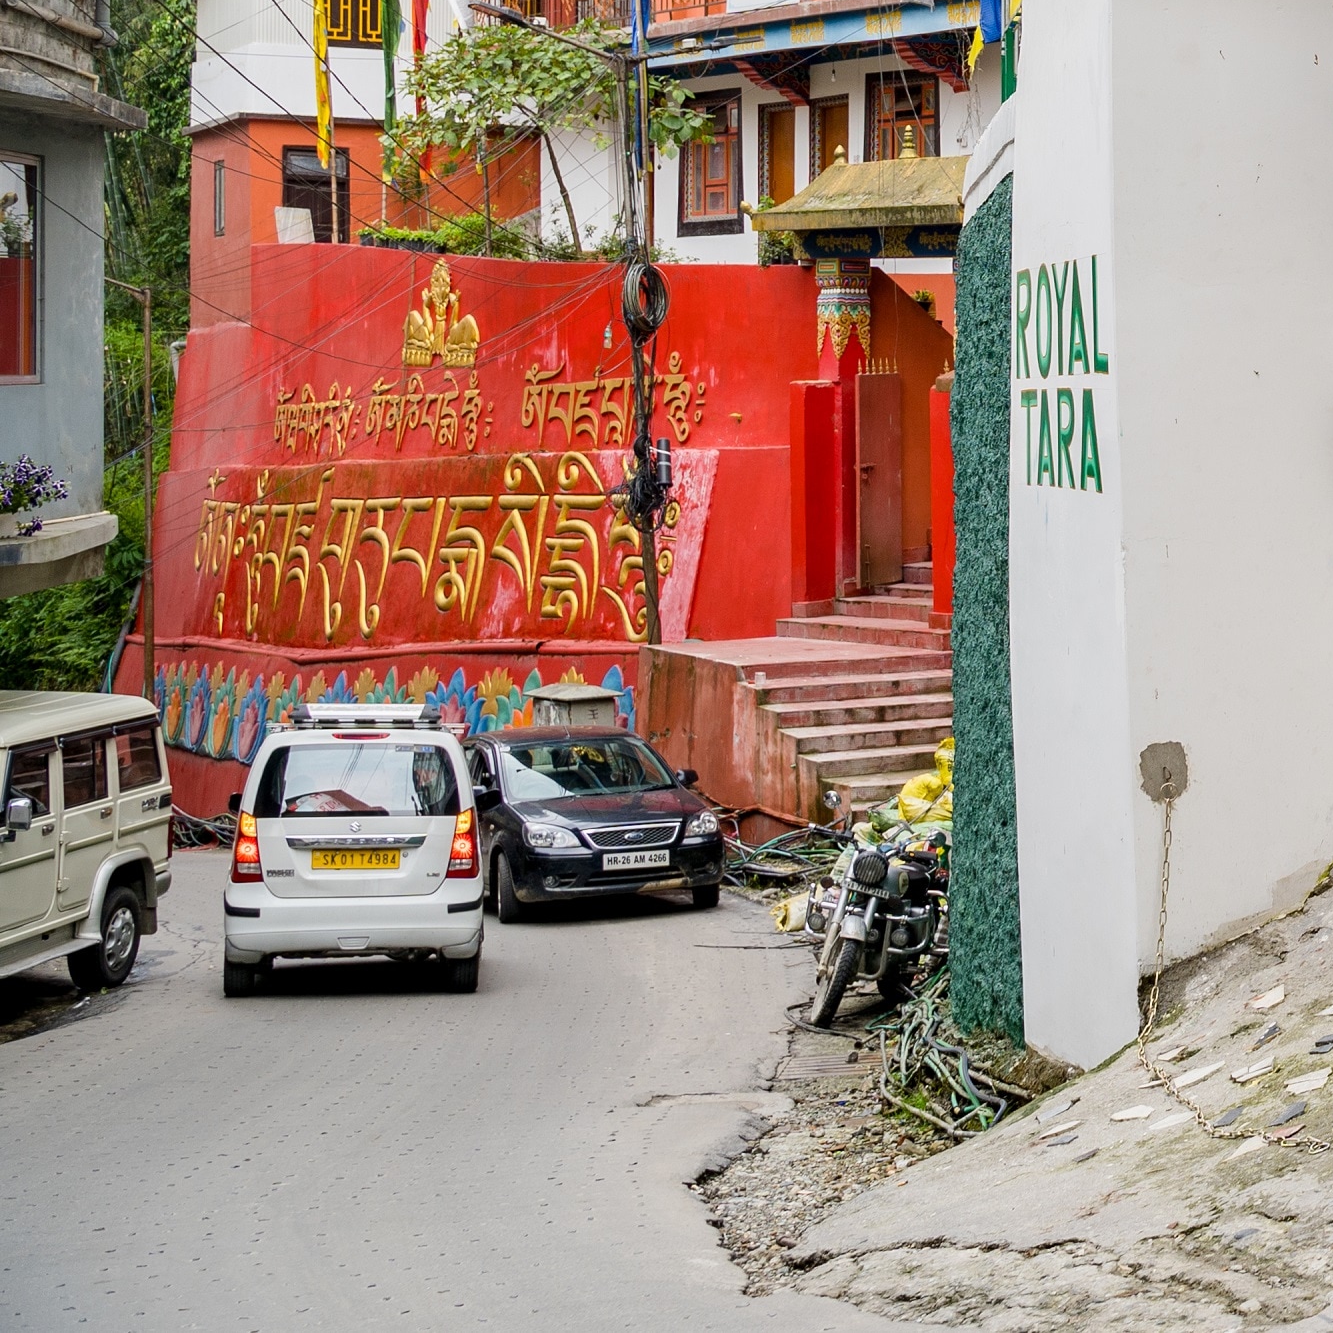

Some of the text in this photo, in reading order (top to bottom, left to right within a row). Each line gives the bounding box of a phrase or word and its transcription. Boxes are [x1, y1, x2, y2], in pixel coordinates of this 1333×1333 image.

[1016, 254, 1109, 380] ROYAL
[1020, 387, 1104, 494] TARA
[322, 854, 337, 866] SK
[633, 854, 646, 864] AM
[648, 853, 667, 863] 4266
